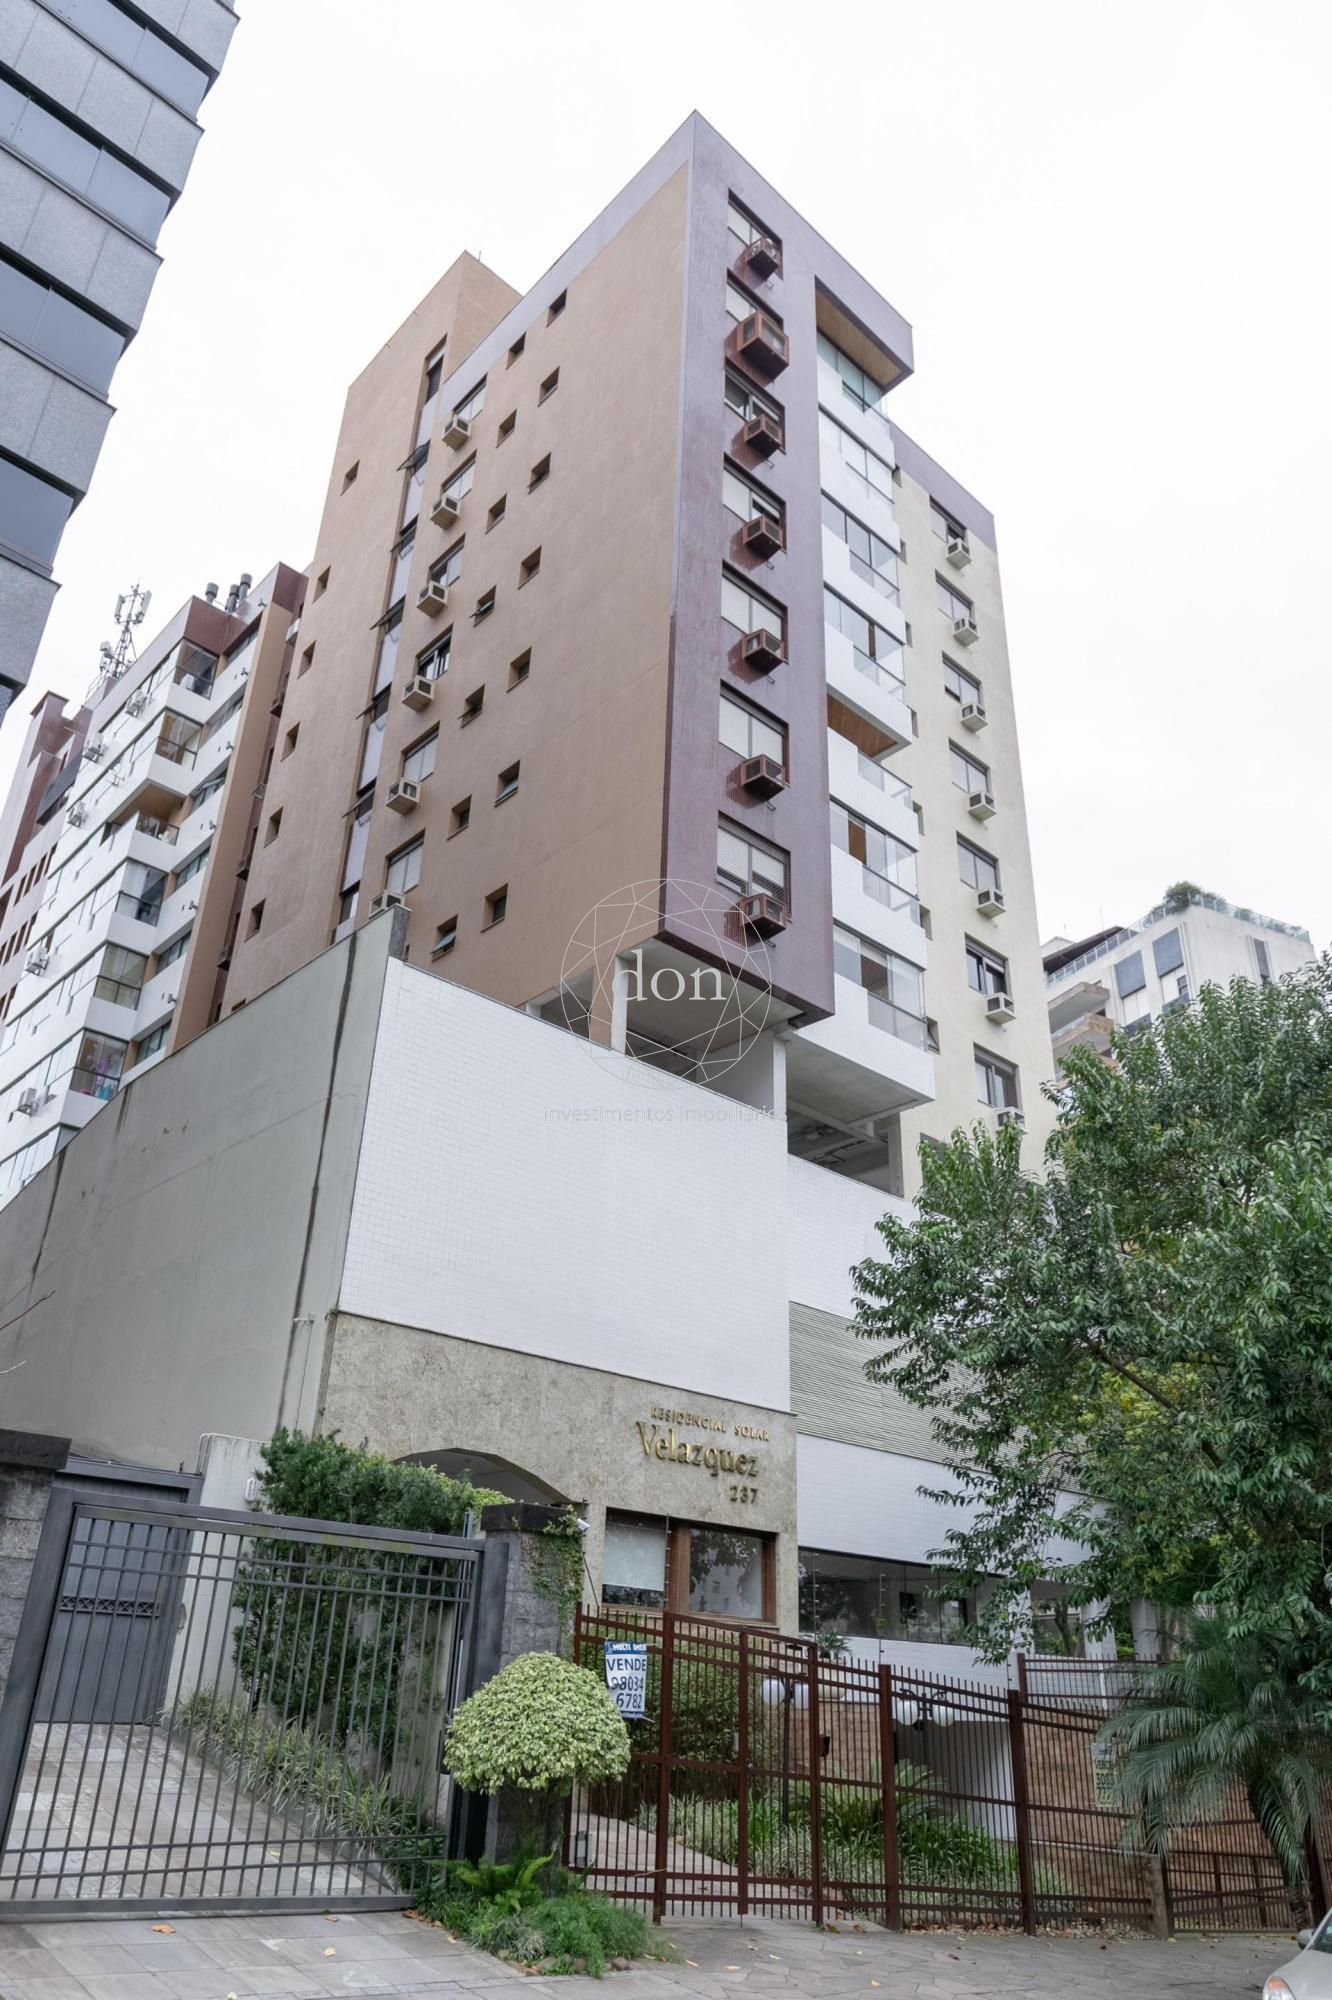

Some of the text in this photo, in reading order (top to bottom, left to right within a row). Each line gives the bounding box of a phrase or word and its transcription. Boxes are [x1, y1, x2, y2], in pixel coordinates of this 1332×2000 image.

[650, 1406, 769, 1442] RESIDENCIAL SOLAR
[636, 1420, 760, 1477] Velazquez
[729, 1485, 758, 1504] 237
[606, 1658, 647, 1671] VENDE
[611, 1676, 644, 1691] 98034
[616, 1692, 643, 1709] 6782
